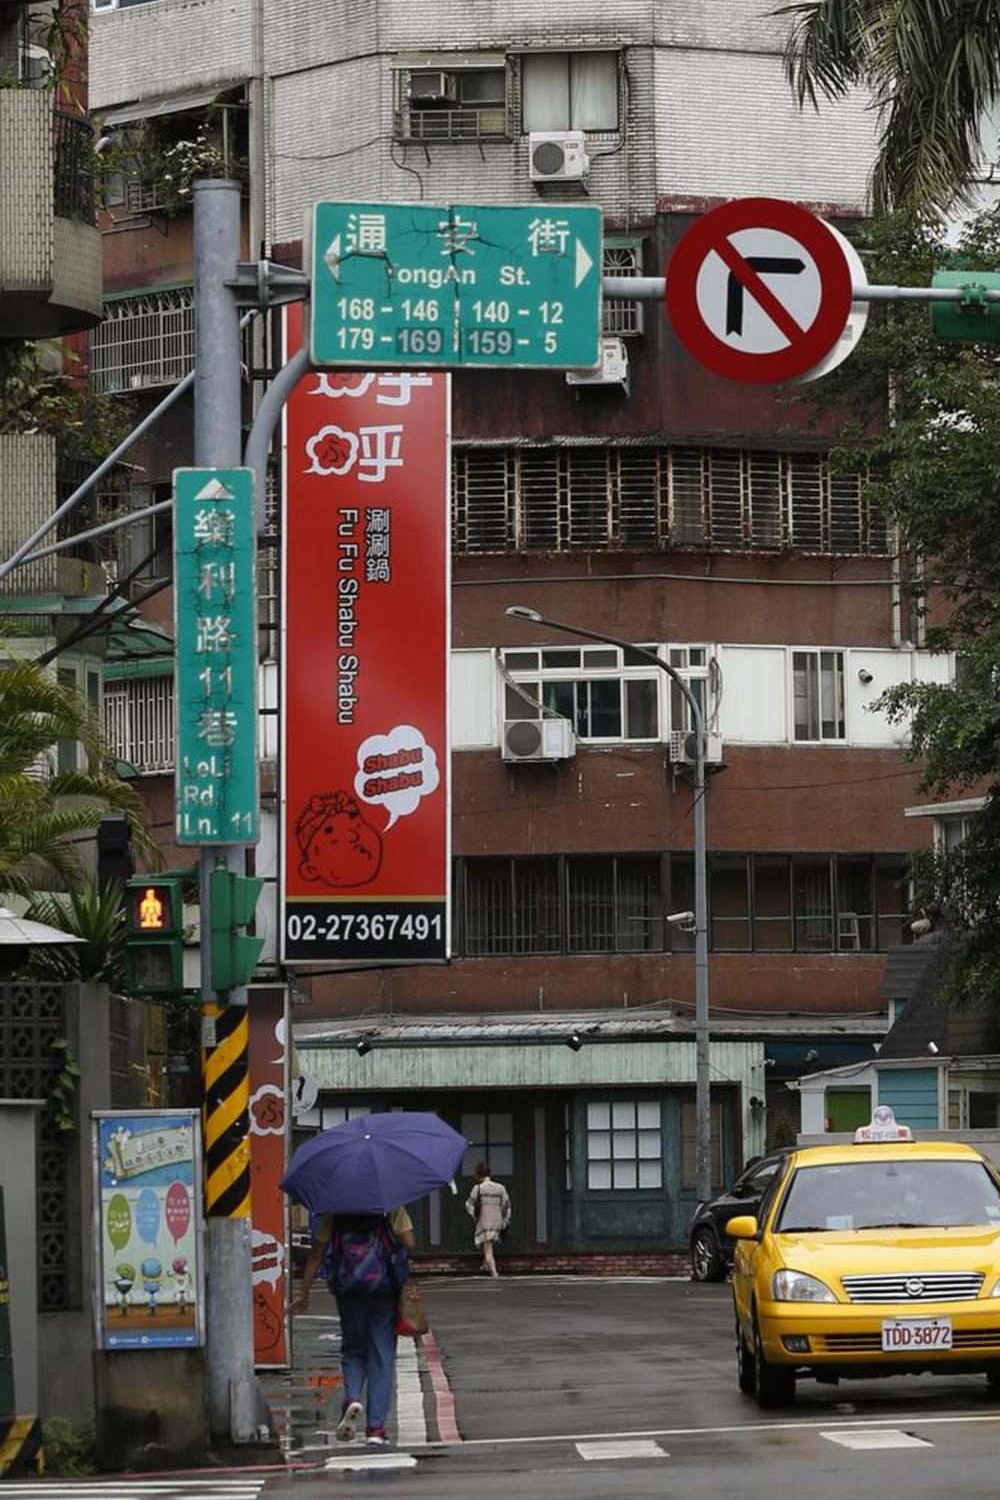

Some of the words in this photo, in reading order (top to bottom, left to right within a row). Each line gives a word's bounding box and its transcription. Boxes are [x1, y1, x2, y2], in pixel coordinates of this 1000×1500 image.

[344, 213, 570, 257] 通安街
[500, 266, 531, 286] St.
[338, 509, 359, 536] Fu
[338, 543, 359, 571] Fu
[365, 508, 390, 583] 涮涮鍋
[338, 578, 359, 648] Shabu
[338, 654, 359, 724] Shabu
[363, 747, 424, 775] Shabu
[363, 770, 424, 798] Shabu
[231, 811, 252, 835] 11
[287, 914, 442, 941] 02-27367491
